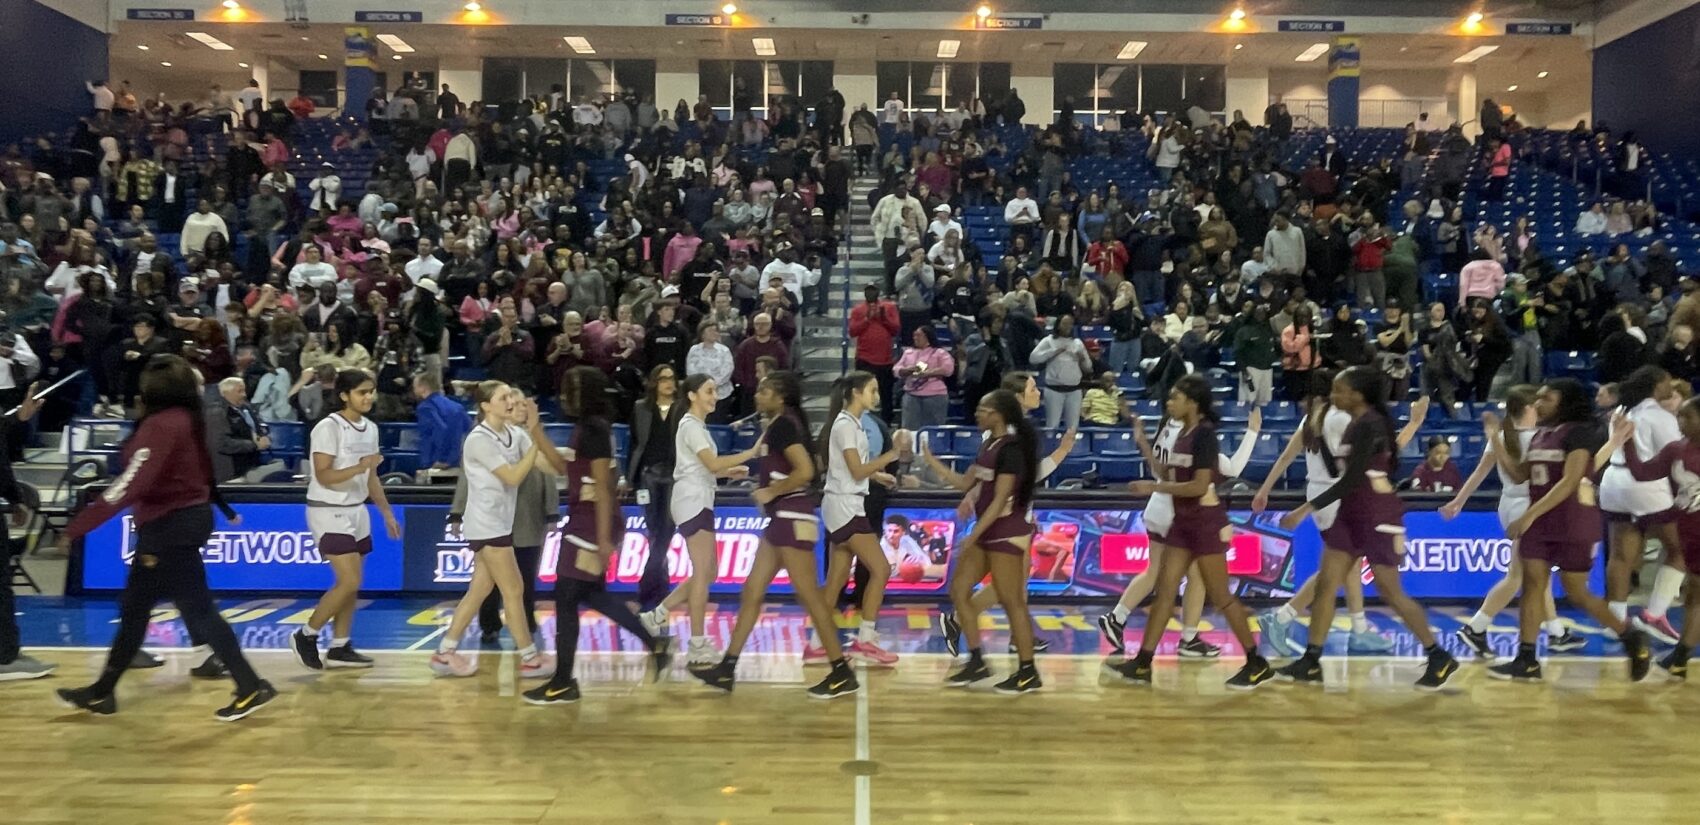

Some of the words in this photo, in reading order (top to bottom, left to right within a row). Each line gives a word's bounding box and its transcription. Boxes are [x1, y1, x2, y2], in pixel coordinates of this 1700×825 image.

[676, 16, 710, 24] SECTION
[986, 19, 1020, 28] SECTION
[723, 516, 772, 530] DEMA
[199, 531, 331, 564] ETWOR
[1398, 538, 1515, 572] NETWO
